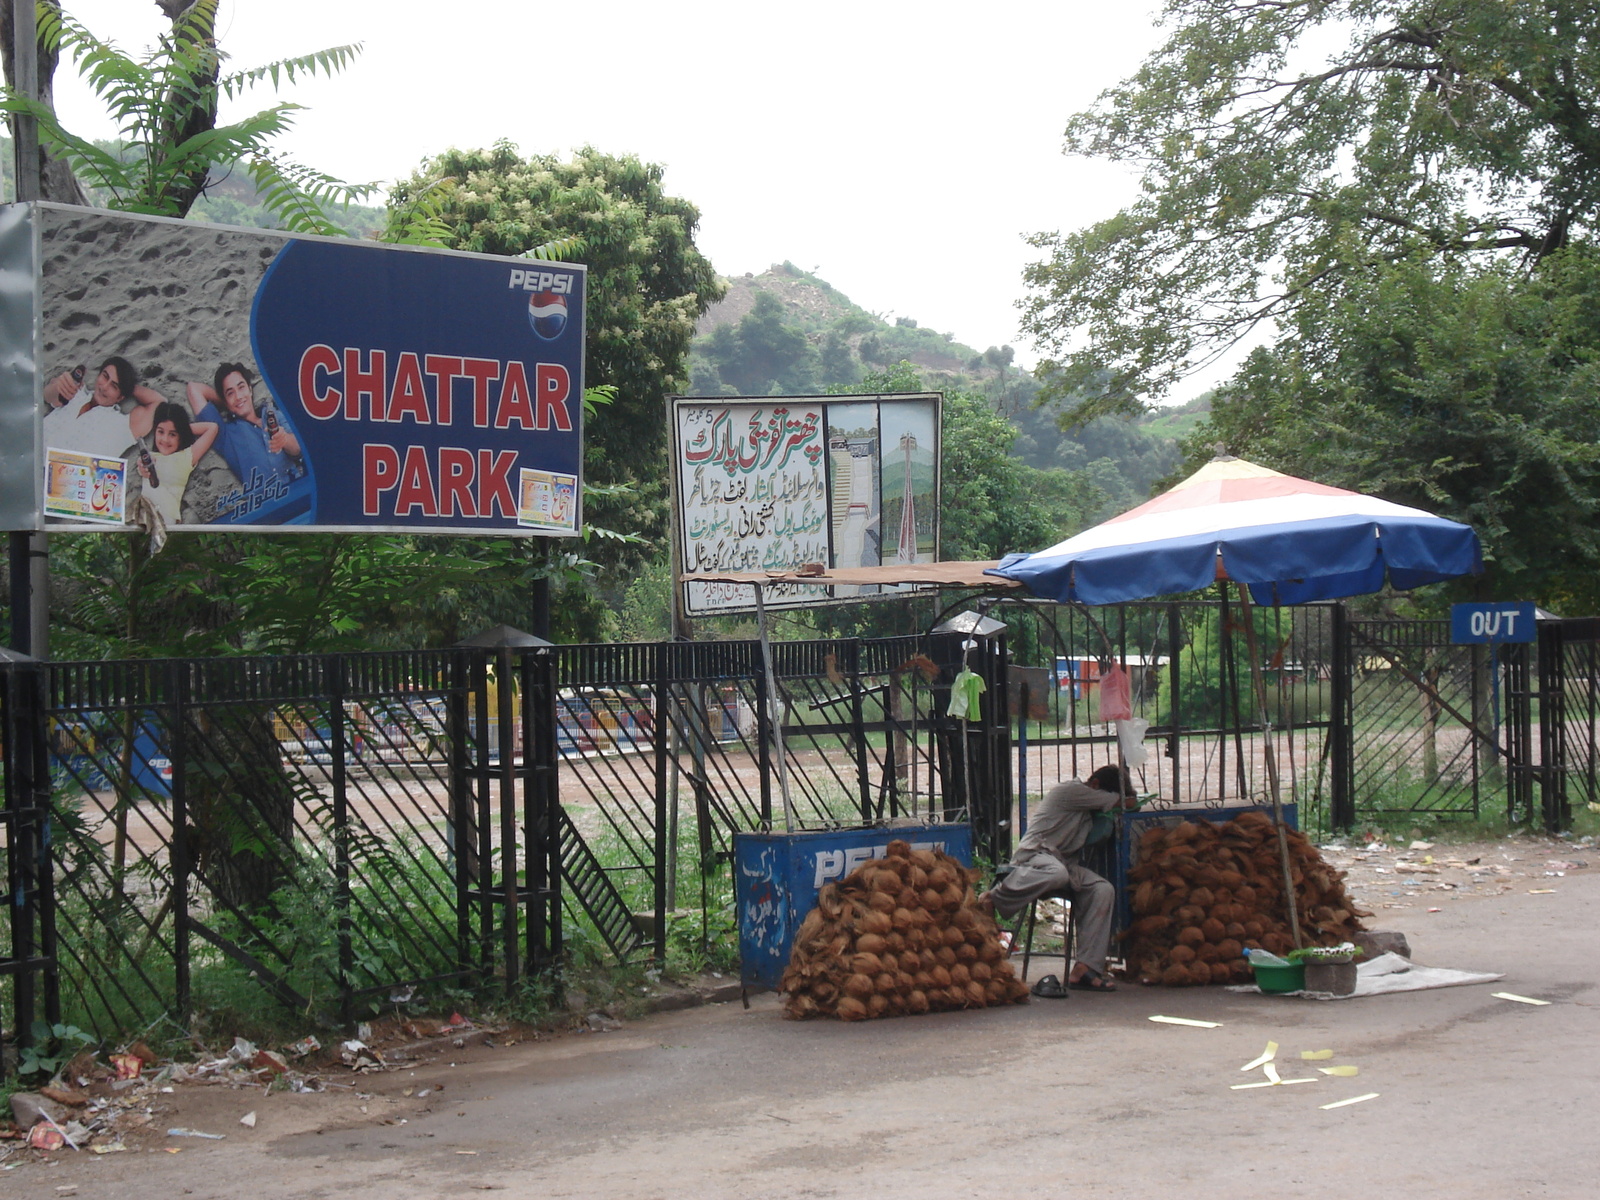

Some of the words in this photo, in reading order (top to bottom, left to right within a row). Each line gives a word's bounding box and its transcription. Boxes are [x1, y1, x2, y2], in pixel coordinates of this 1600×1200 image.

[508, 268, 574, 294] PEPSI
[298, 343, 572, 431] CHATTAR
[706, 409, 713, 424] 5
[685, 407, 739, 478] پارک
[243, 466, 264, 495] دل
[362, 443, 519, 519] PARK
[723, 476, 747, 504] لفٹ
[1471, 611, 1520, 636] OUT
